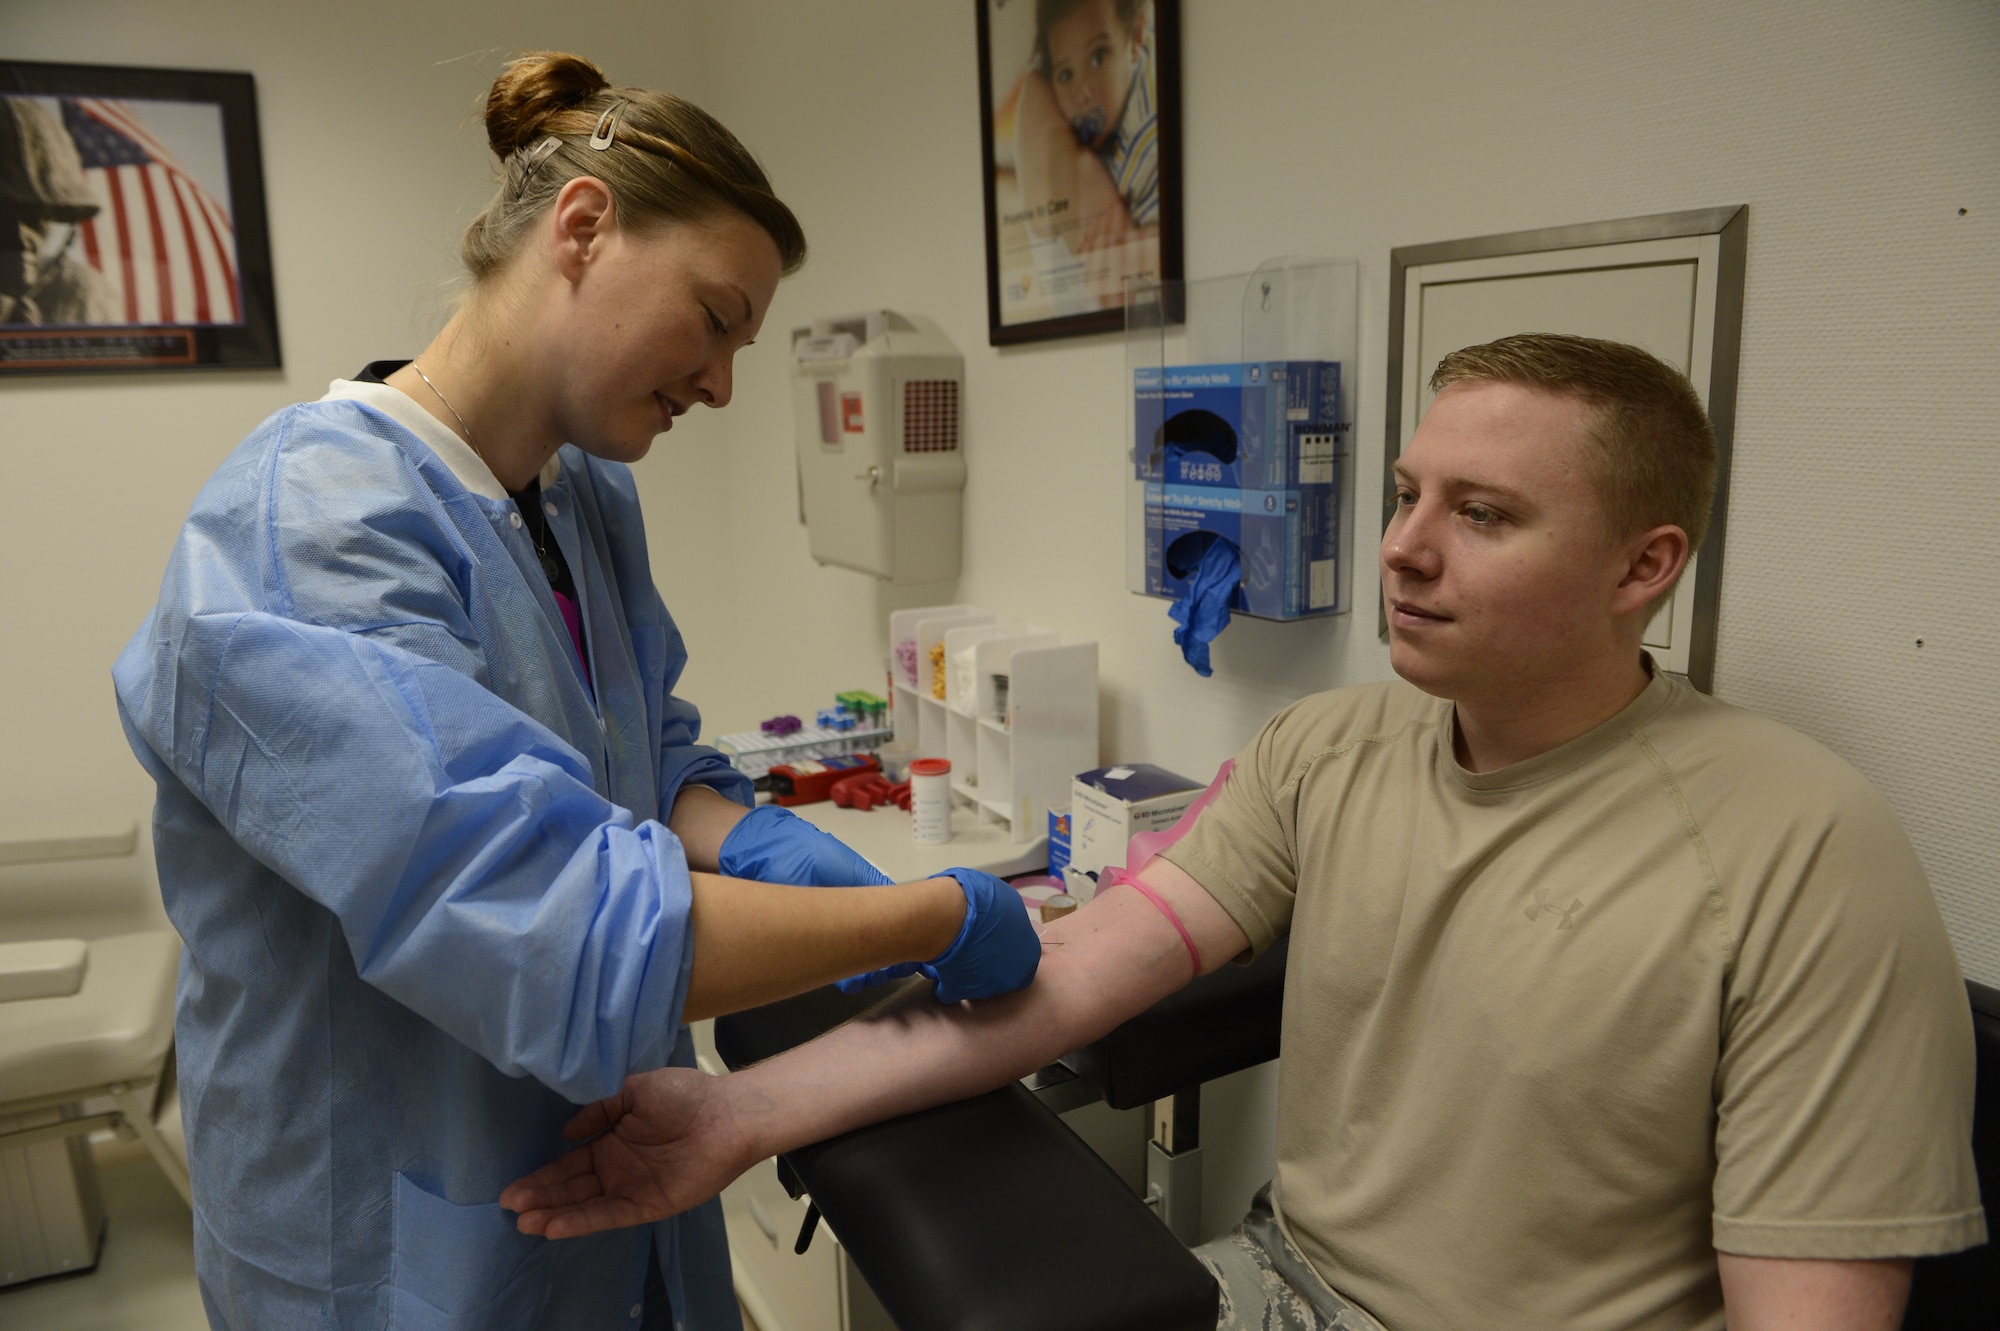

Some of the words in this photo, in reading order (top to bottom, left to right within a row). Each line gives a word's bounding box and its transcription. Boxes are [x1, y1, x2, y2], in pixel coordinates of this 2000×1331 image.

[1047, 197, 1070, 216] Care
[1294, 421, 1350, 434] BOWMAN
[1151, 804, 1186, 817] Microtainer
